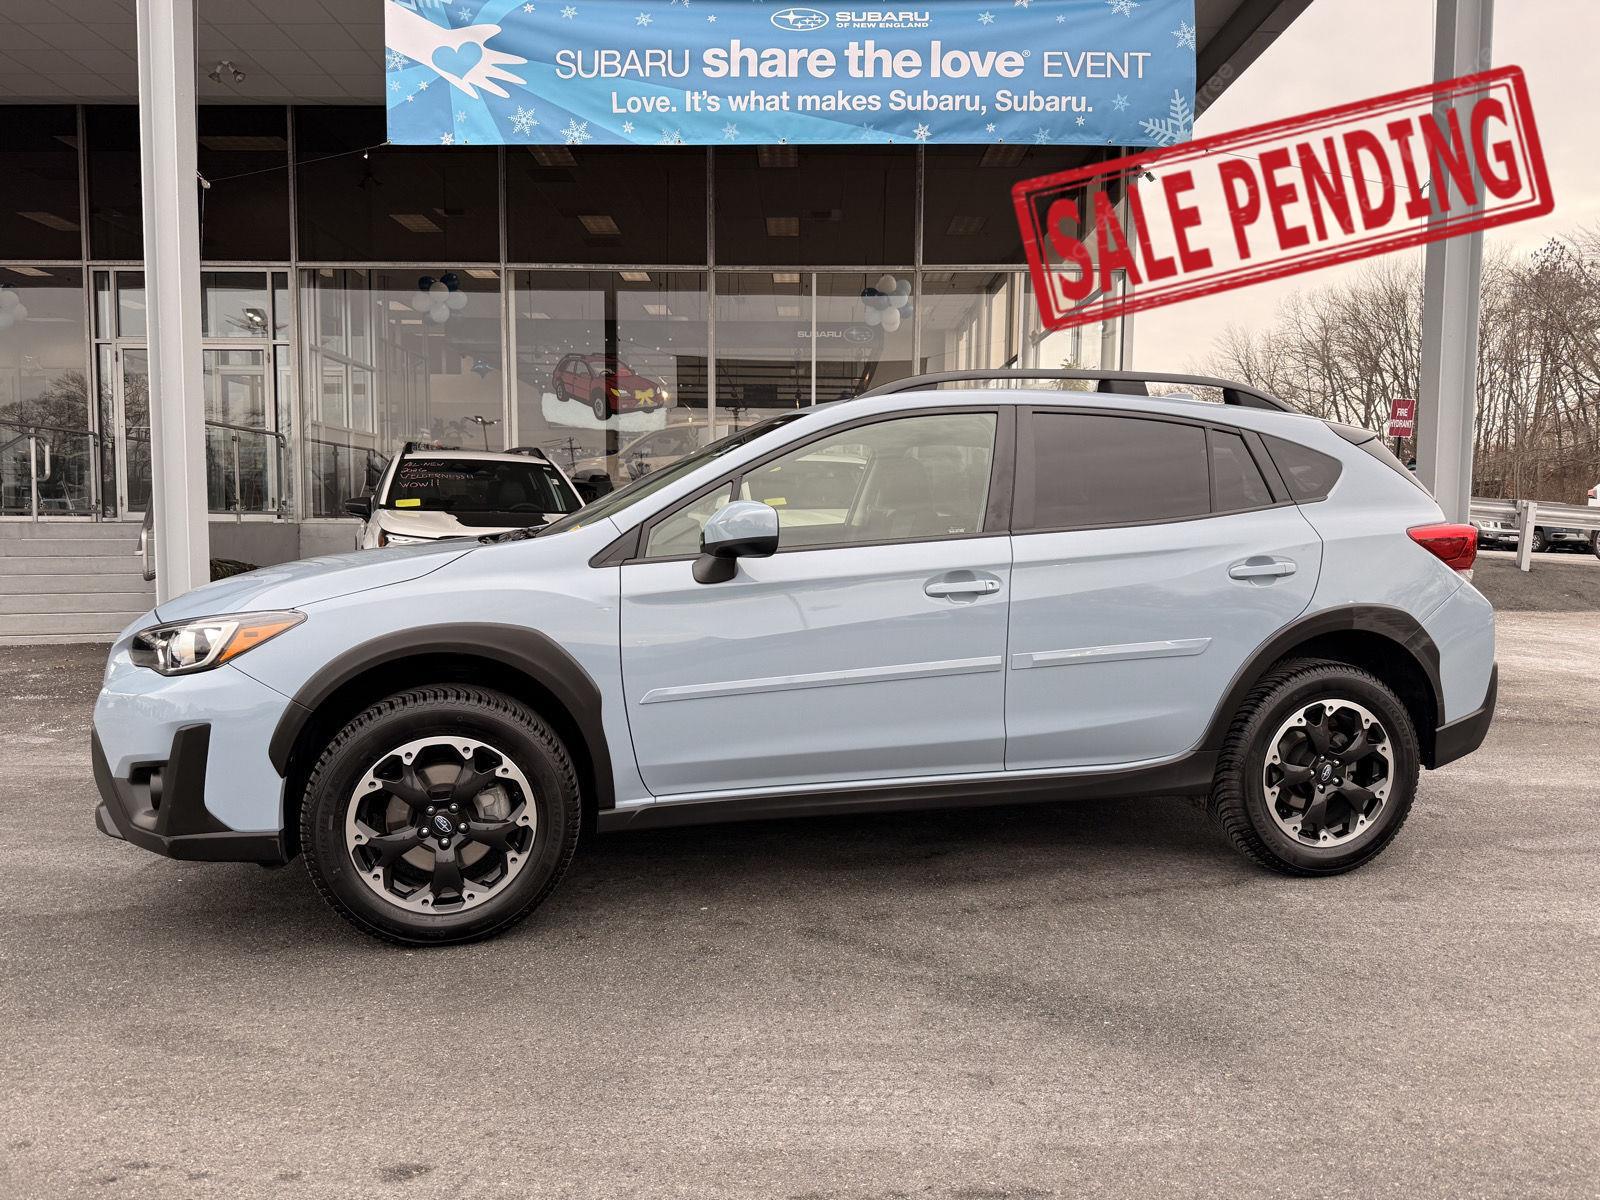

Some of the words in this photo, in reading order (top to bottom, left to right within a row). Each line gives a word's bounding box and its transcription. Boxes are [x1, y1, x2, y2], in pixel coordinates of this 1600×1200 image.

[835, 11, 930, 22] SUBARU
[555, 49, 690, 79] SUBARU
[702, 39, 836, 79] share
[844, 39, 922, 79] the
[1043, 51, 1151, 79] EVENT
[611, 91, 677, 113] Love.
[685, 90, 721, 112] It’s
[728, 90, 790, 112] what
[797, 90, 881, 111] makes
[888, 89, 987, 116] Subaru,
[995, 89, 1093, 112] Subaru.
